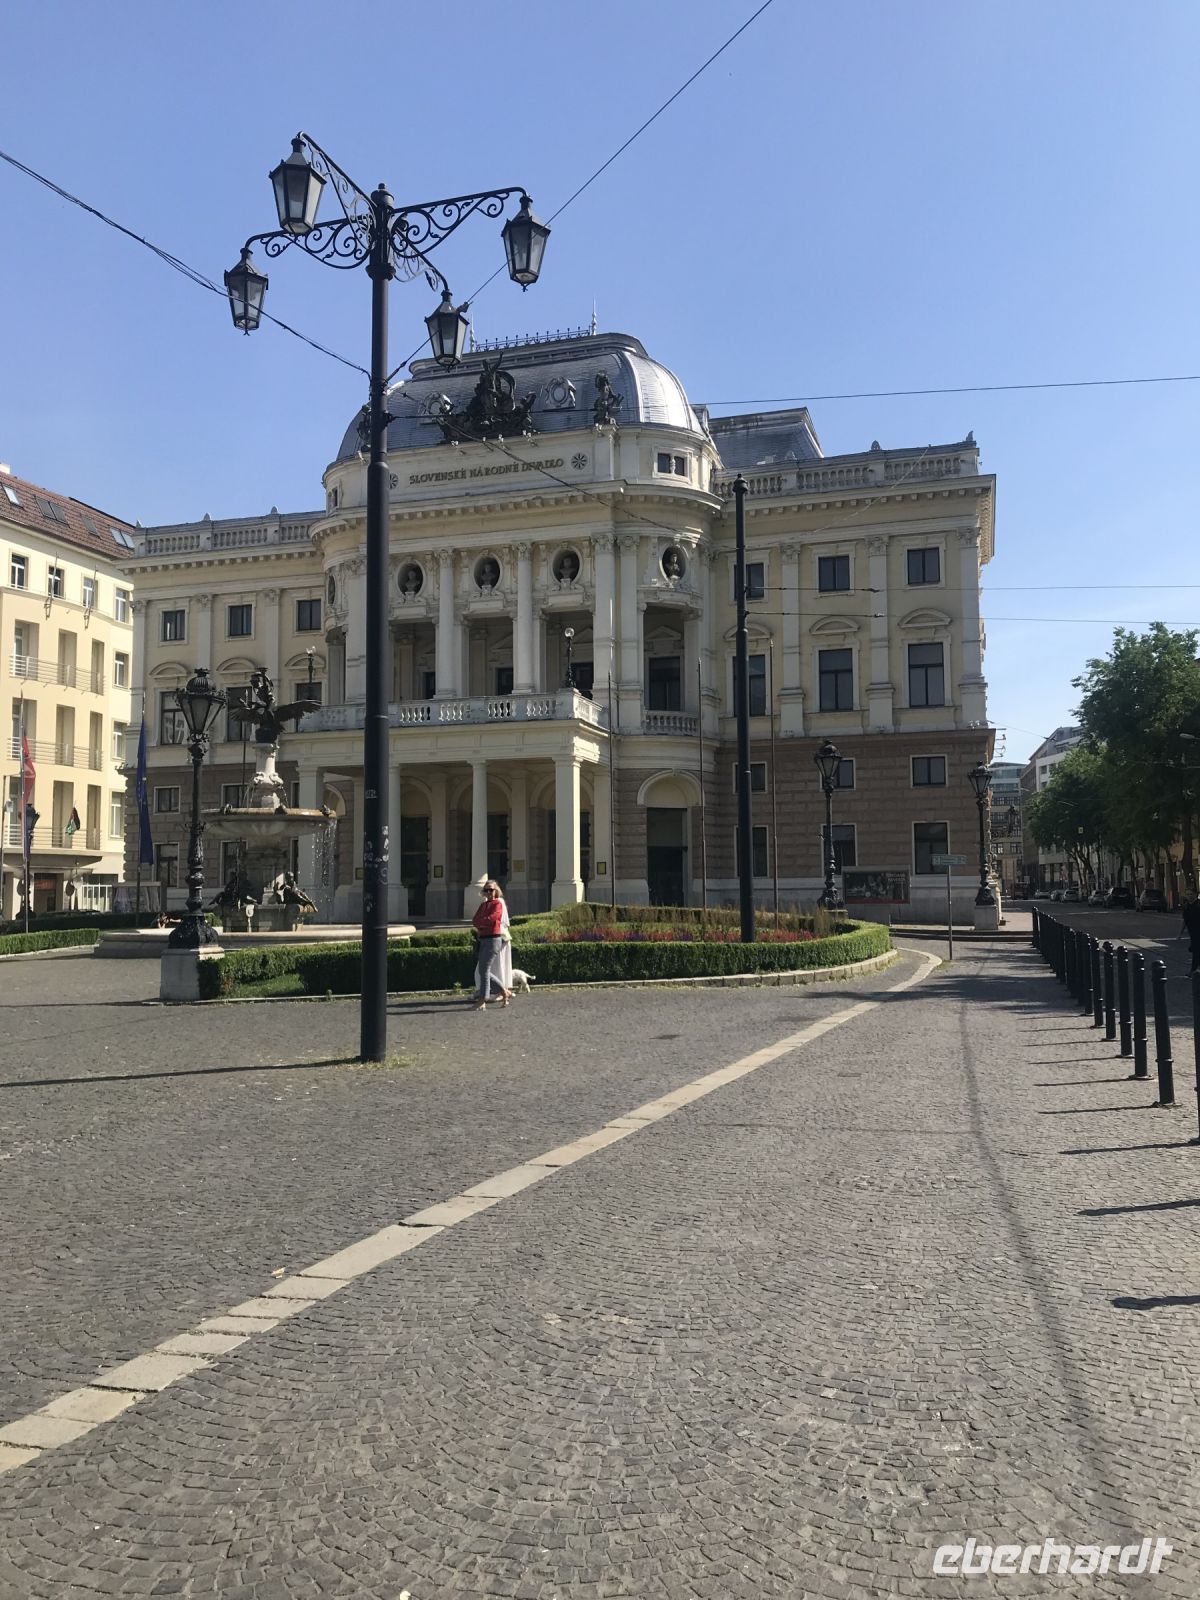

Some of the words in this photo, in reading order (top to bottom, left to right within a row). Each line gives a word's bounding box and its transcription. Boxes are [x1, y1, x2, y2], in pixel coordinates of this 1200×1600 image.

[409, 468, 467, 484] SLOVENSKÉ
[469, 462, 520, 478] NÁRODNÉ
[521, 458, 564, 471] DIVADLO
